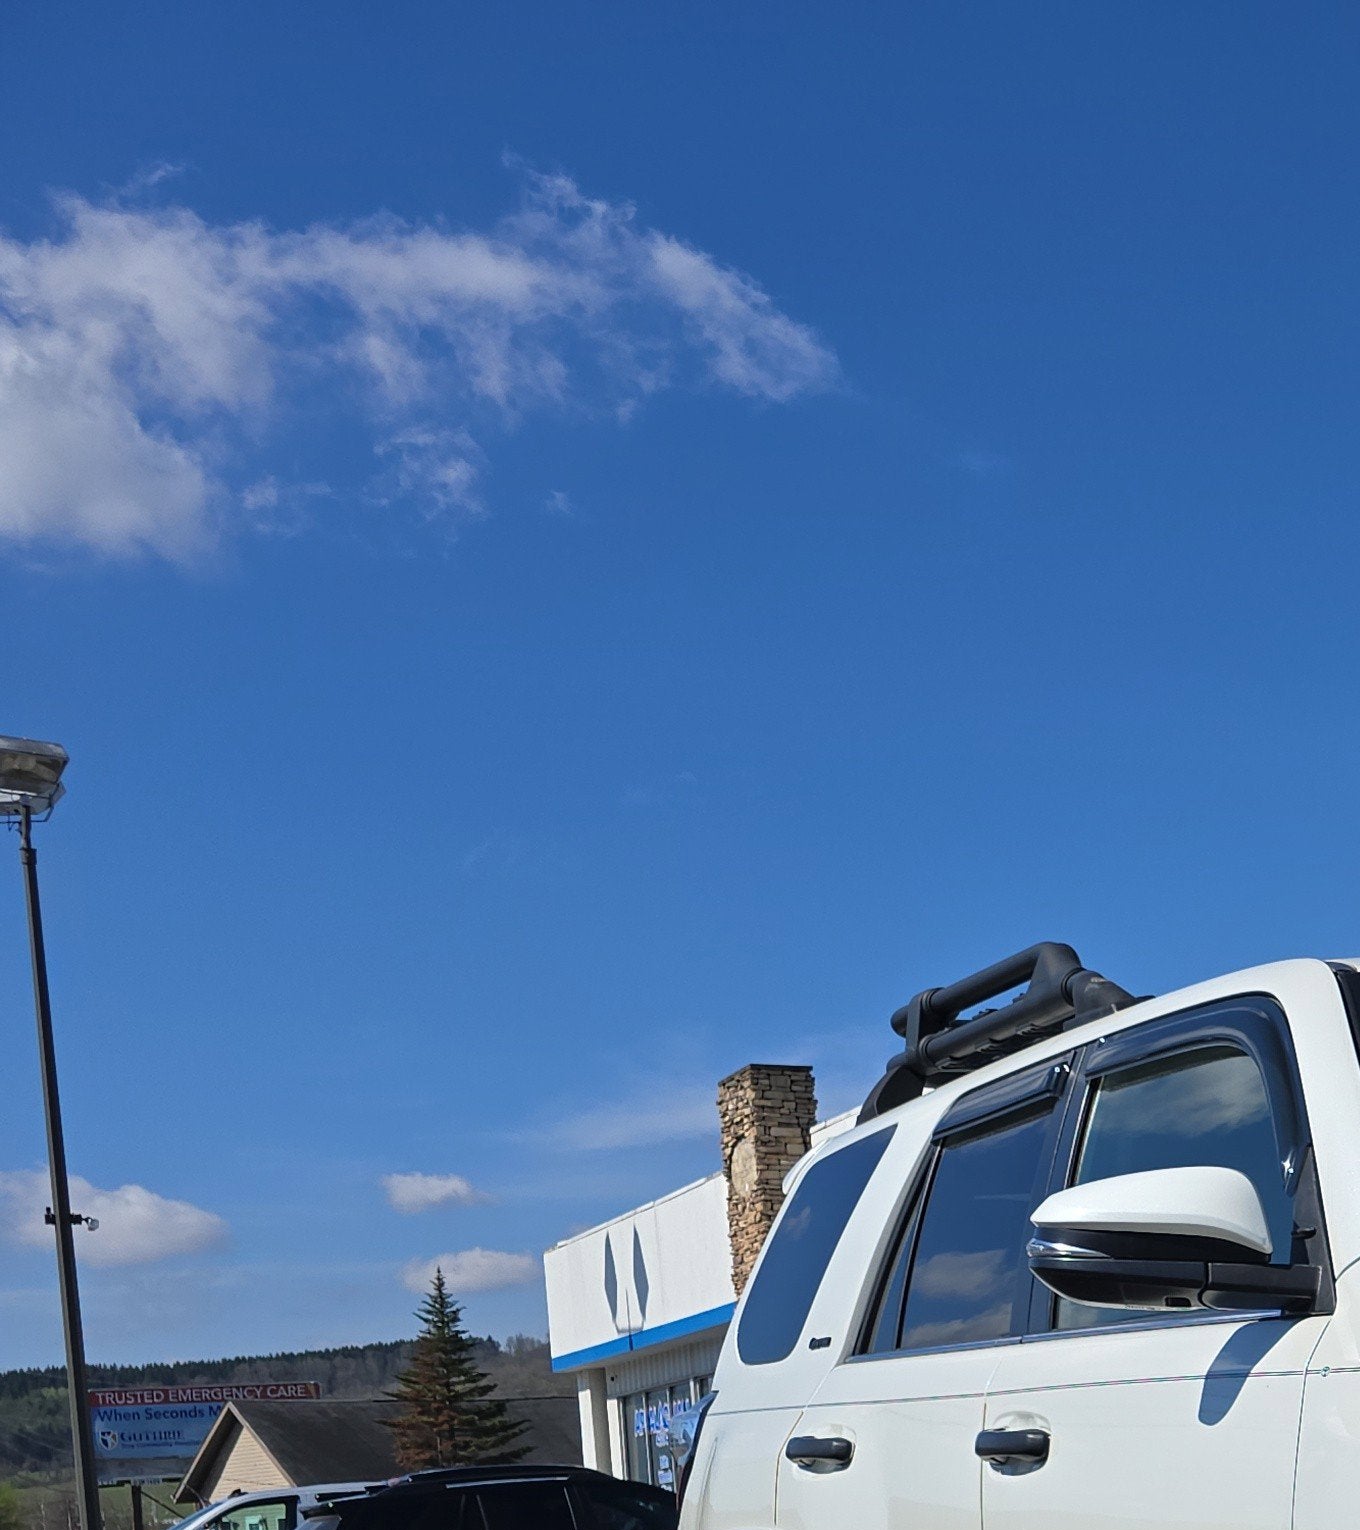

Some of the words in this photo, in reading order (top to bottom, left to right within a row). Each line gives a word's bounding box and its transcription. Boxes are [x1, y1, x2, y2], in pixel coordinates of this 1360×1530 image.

[96, 1390, 165, 1405] TRUSTED
[168, 1387, 262, 1403] EMERGENCY
[266, 1384, 306, 1398] CARE
[98, 1407, 141, 1422] When
[145, 1404, 205, 1420] Seconds
